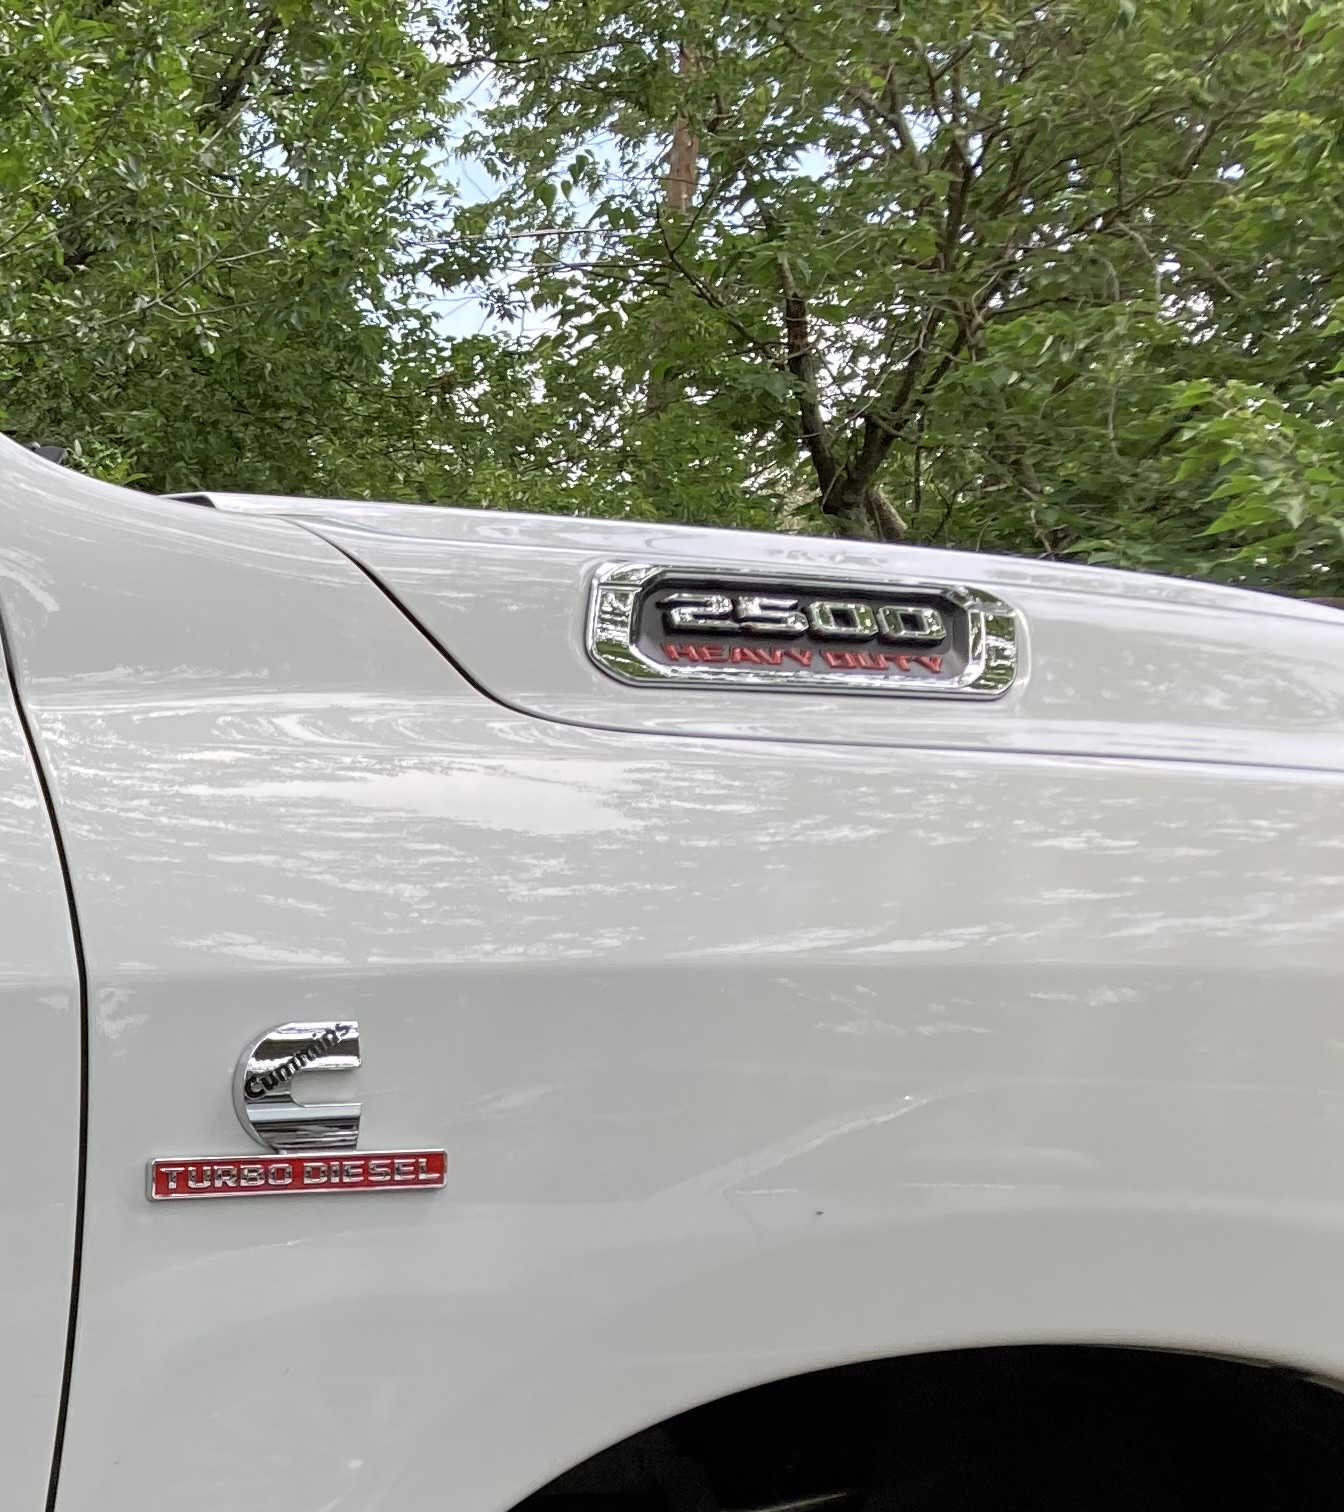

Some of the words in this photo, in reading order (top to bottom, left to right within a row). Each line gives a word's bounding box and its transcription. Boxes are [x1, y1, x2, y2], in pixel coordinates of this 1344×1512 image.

[657, 593, 948, 642] 2500
[661, 642, 814, 668] HEAVY
[820, 650, 945, 675] DUTY
[244, 1022, 353, 1099] Cummins
[160, 1163, 293, 1189] TURBO
[303, 1158, 440, 1184] DIESEL
